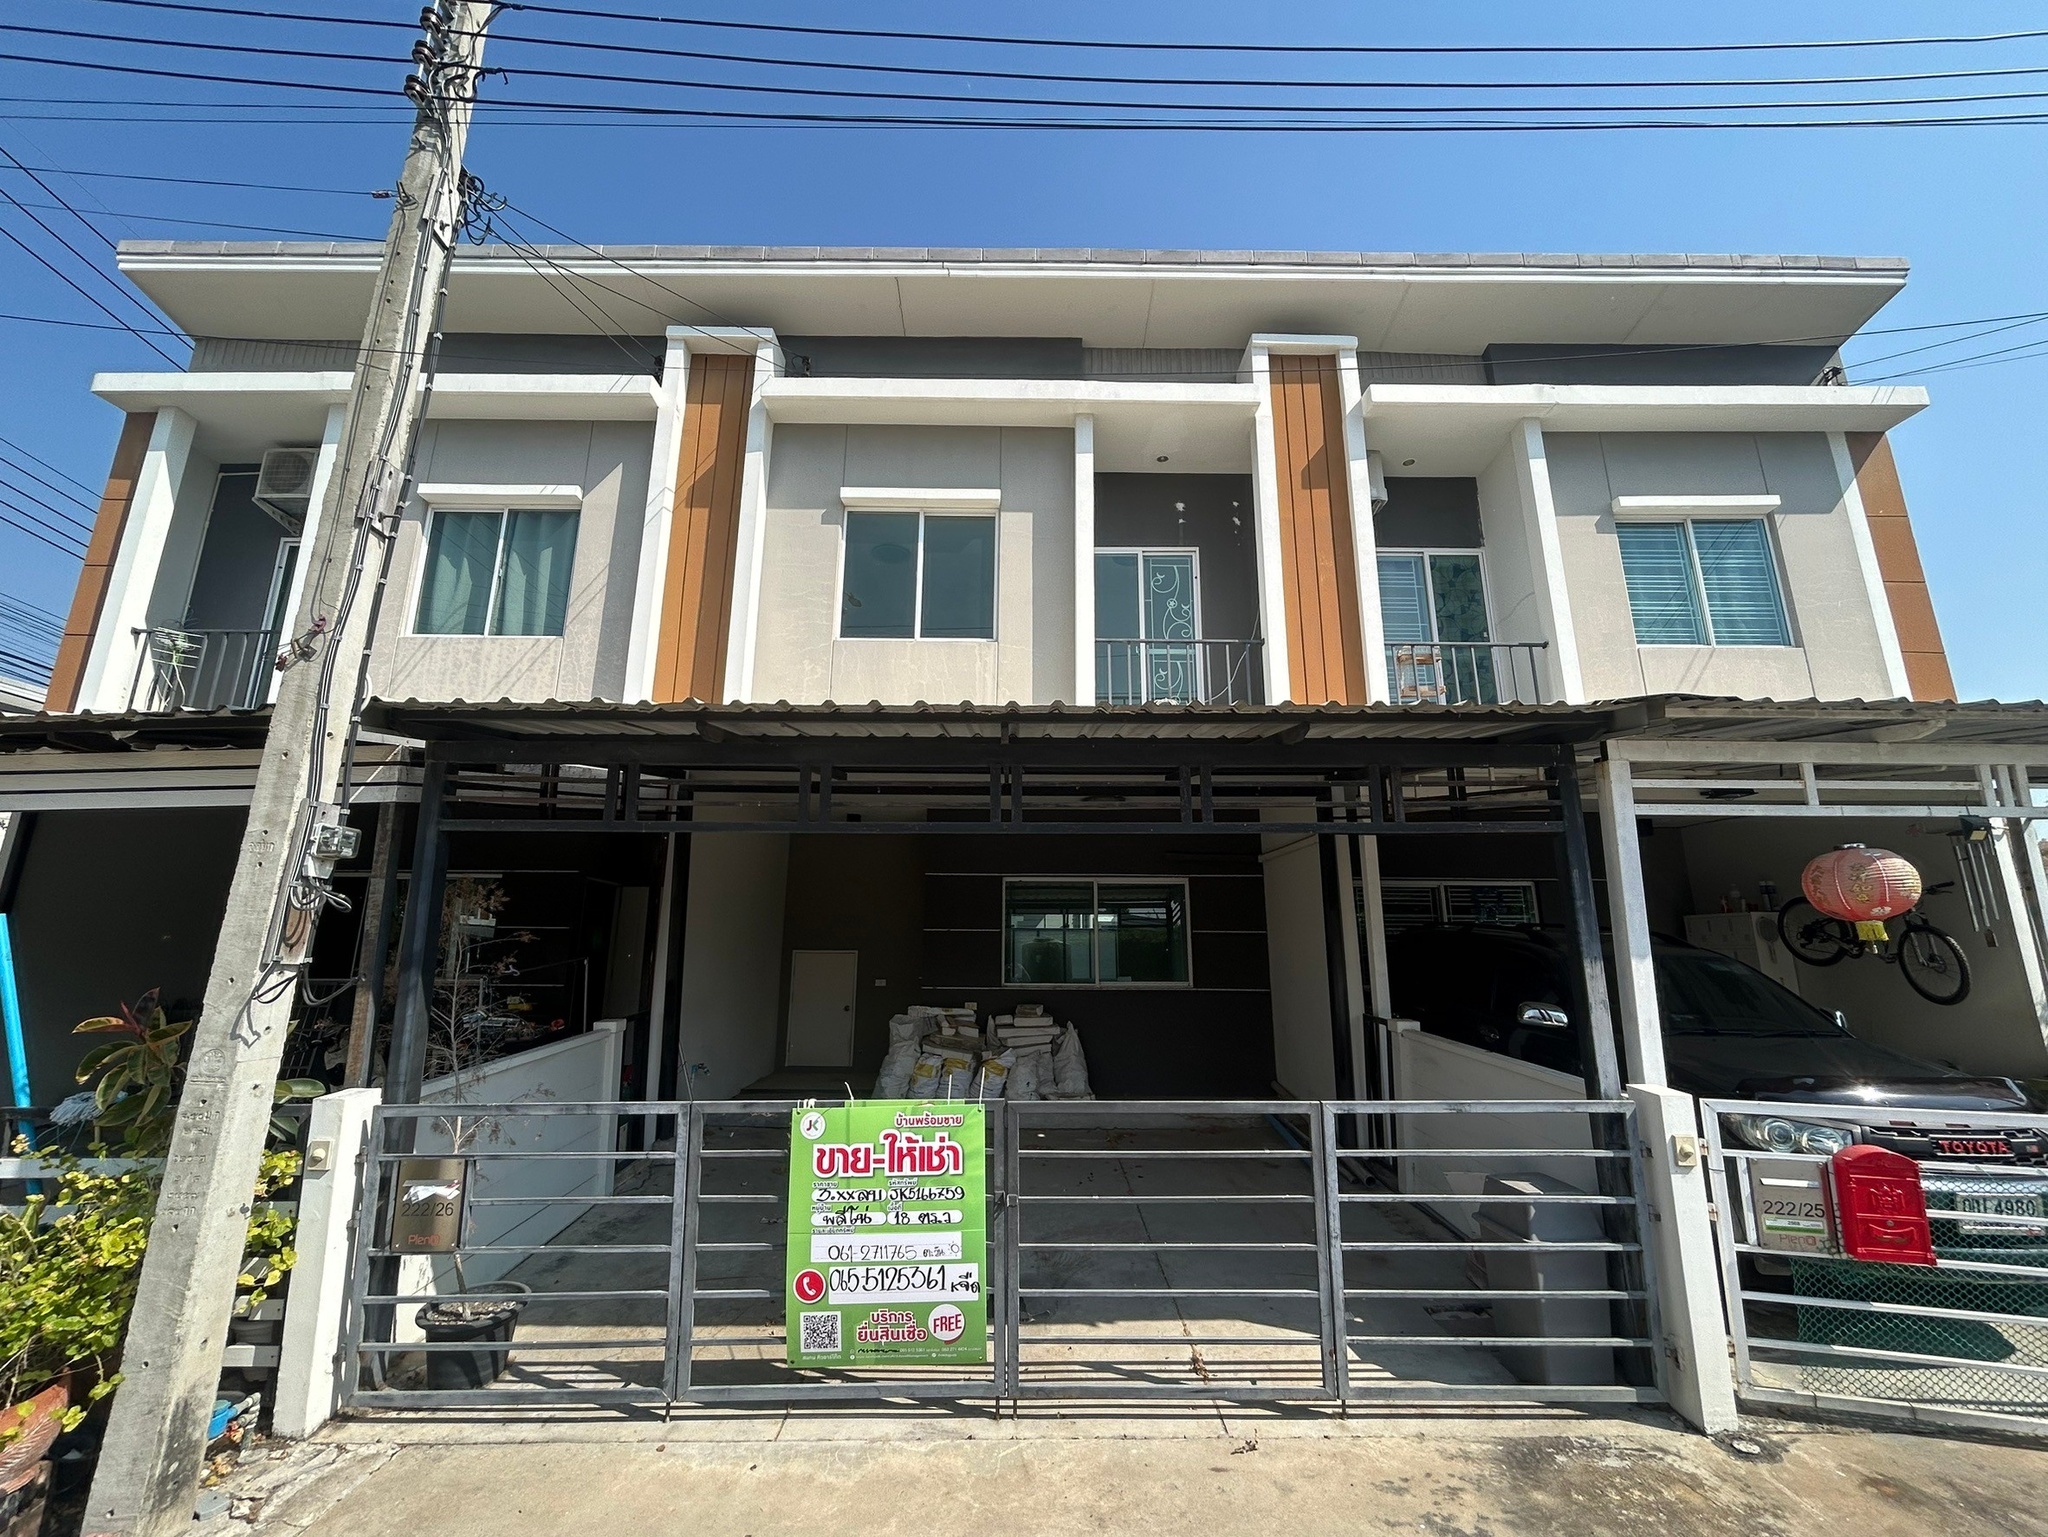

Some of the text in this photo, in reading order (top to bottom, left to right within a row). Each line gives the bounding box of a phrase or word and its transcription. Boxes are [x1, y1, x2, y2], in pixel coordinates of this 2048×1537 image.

[896, 1112, 962, 1127] บ้านพร้อมขาย
[816, 1133, 960, 1174] ขาย-ให้เช่า
[1938, 1140, 2012, 1154] TOYOTA
[401, 1202, 454, 1217] 222/26
[894, 1211, 910, 1225] 18
[1762, 1200, 1825, 1218] 222/25
[827, 1244, 917, 1263] 061-2711765
[829, 1265, 947, 1292] 065-5125361
[871, 1311, 912, 1323] บริการ
[933, 1314, 962, 1334] FREE
[857, 1322, 928, 1342] ยื่นสินเชื่อ
